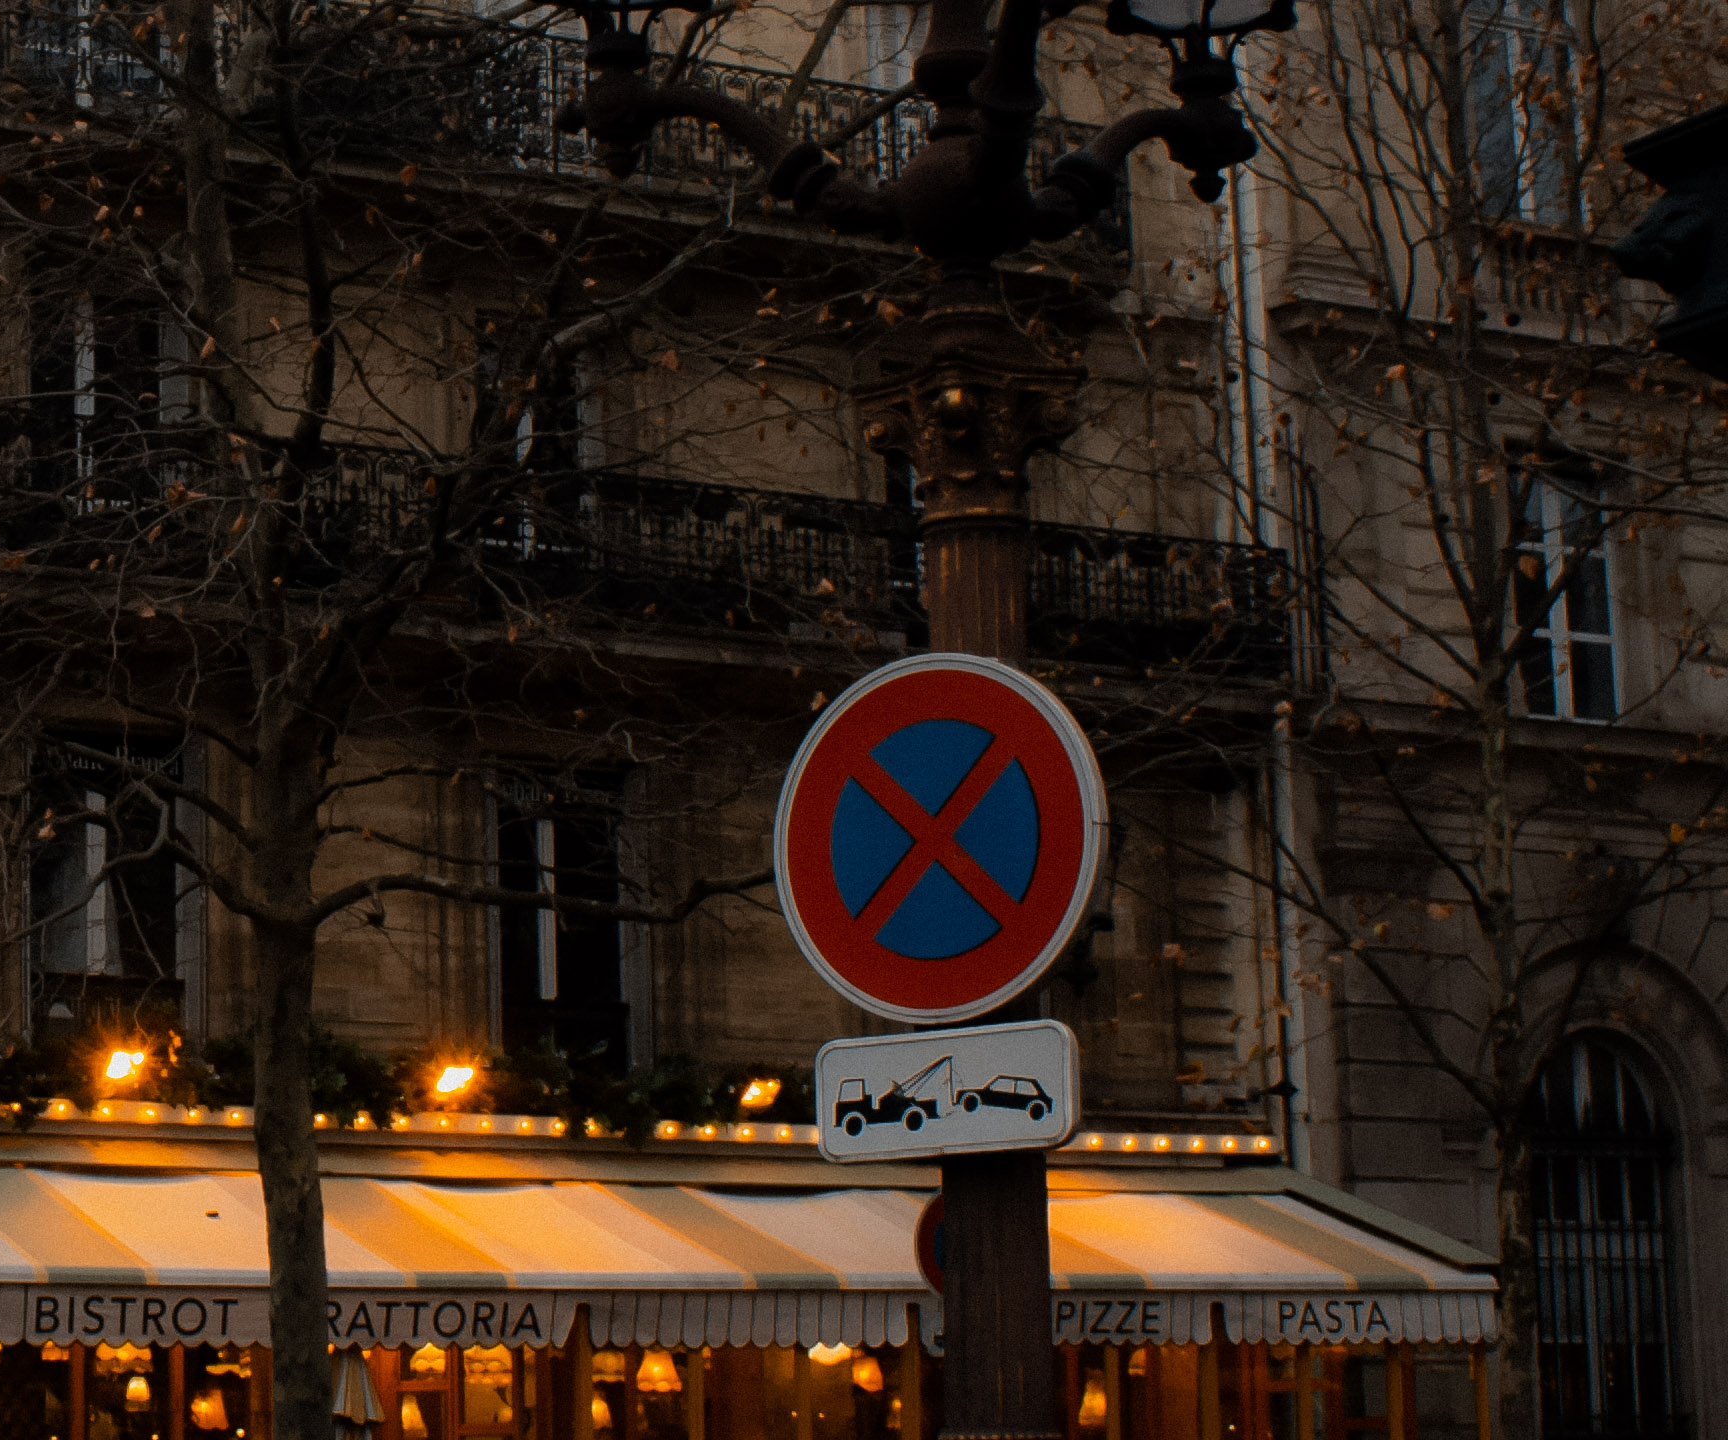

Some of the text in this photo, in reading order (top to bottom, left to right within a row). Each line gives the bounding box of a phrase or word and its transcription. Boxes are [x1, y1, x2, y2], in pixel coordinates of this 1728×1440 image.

[35, 1296, 541, 1338] BISTROT RATTORIA
[1055, 1300, 1160, 1334] PIZZE
[1278, 1300, 1390, 1333] PASTA
